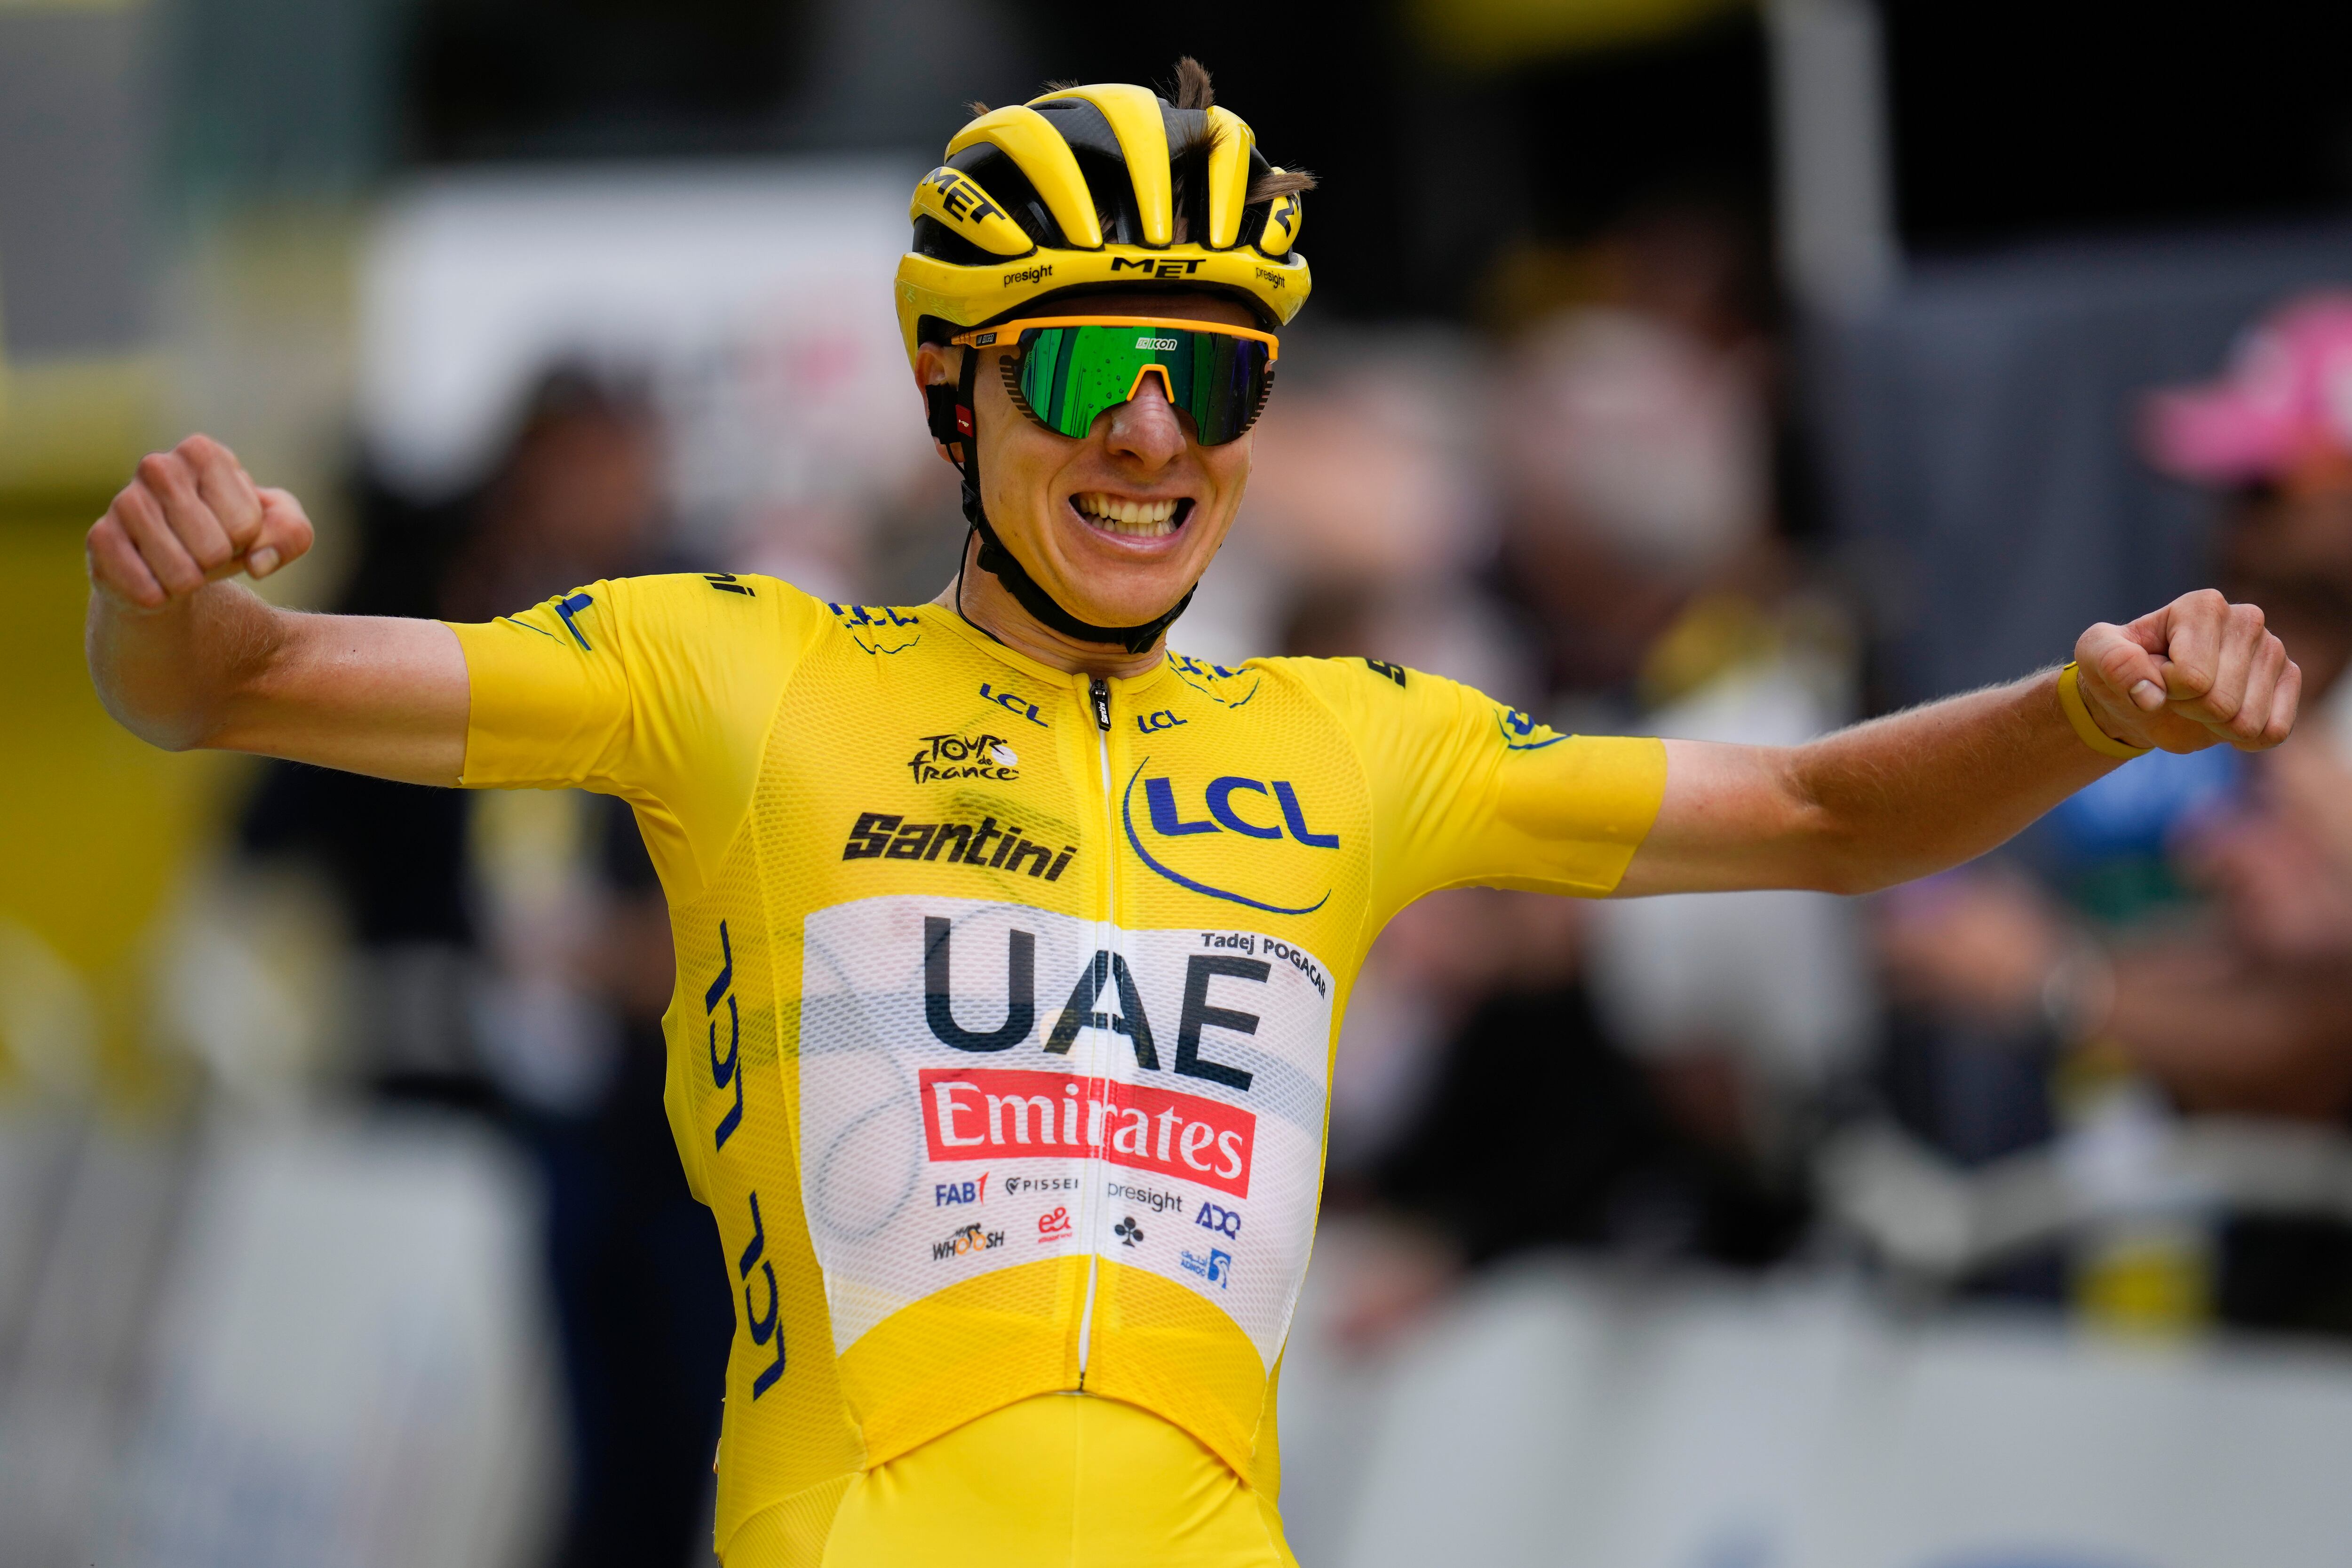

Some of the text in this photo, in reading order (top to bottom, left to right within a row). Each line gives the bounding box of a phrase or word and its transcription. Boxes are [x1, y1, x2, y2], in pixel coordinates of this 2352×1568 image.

[922, 167, 1006, 224] MET
[1004, 264, 1053, 288] presight
[1111, 257, 1206, 279] MET
[1255, 267, 1285, 288] presight
[980, 683, 1049, 728] LCL
[1098, 701, 1109, 724] Santini
[1137, 710, 1188, 733] LCL
[977, 754, 993, 765] de
[1144, 776, 1339, 850] LCL
[842, 812, 1078, 882] Santini
[1201, 933, 1326, 1000] Tadej POGACAR
[924, 915, 1271, 1091] UAE
[706, 918, 743, 1153] LCL
[931, 1081, 1244, 1180] Emirates
[1024, 1179, 1078, 1191] PISSEI
[1108, 1182, 1183, 1212] presight
[1195, 1202, 1241, 1241] ADQ
[933, 1231, 1004, 1261] WHOOSH
[739, 1190, 786, 1401] LCL
